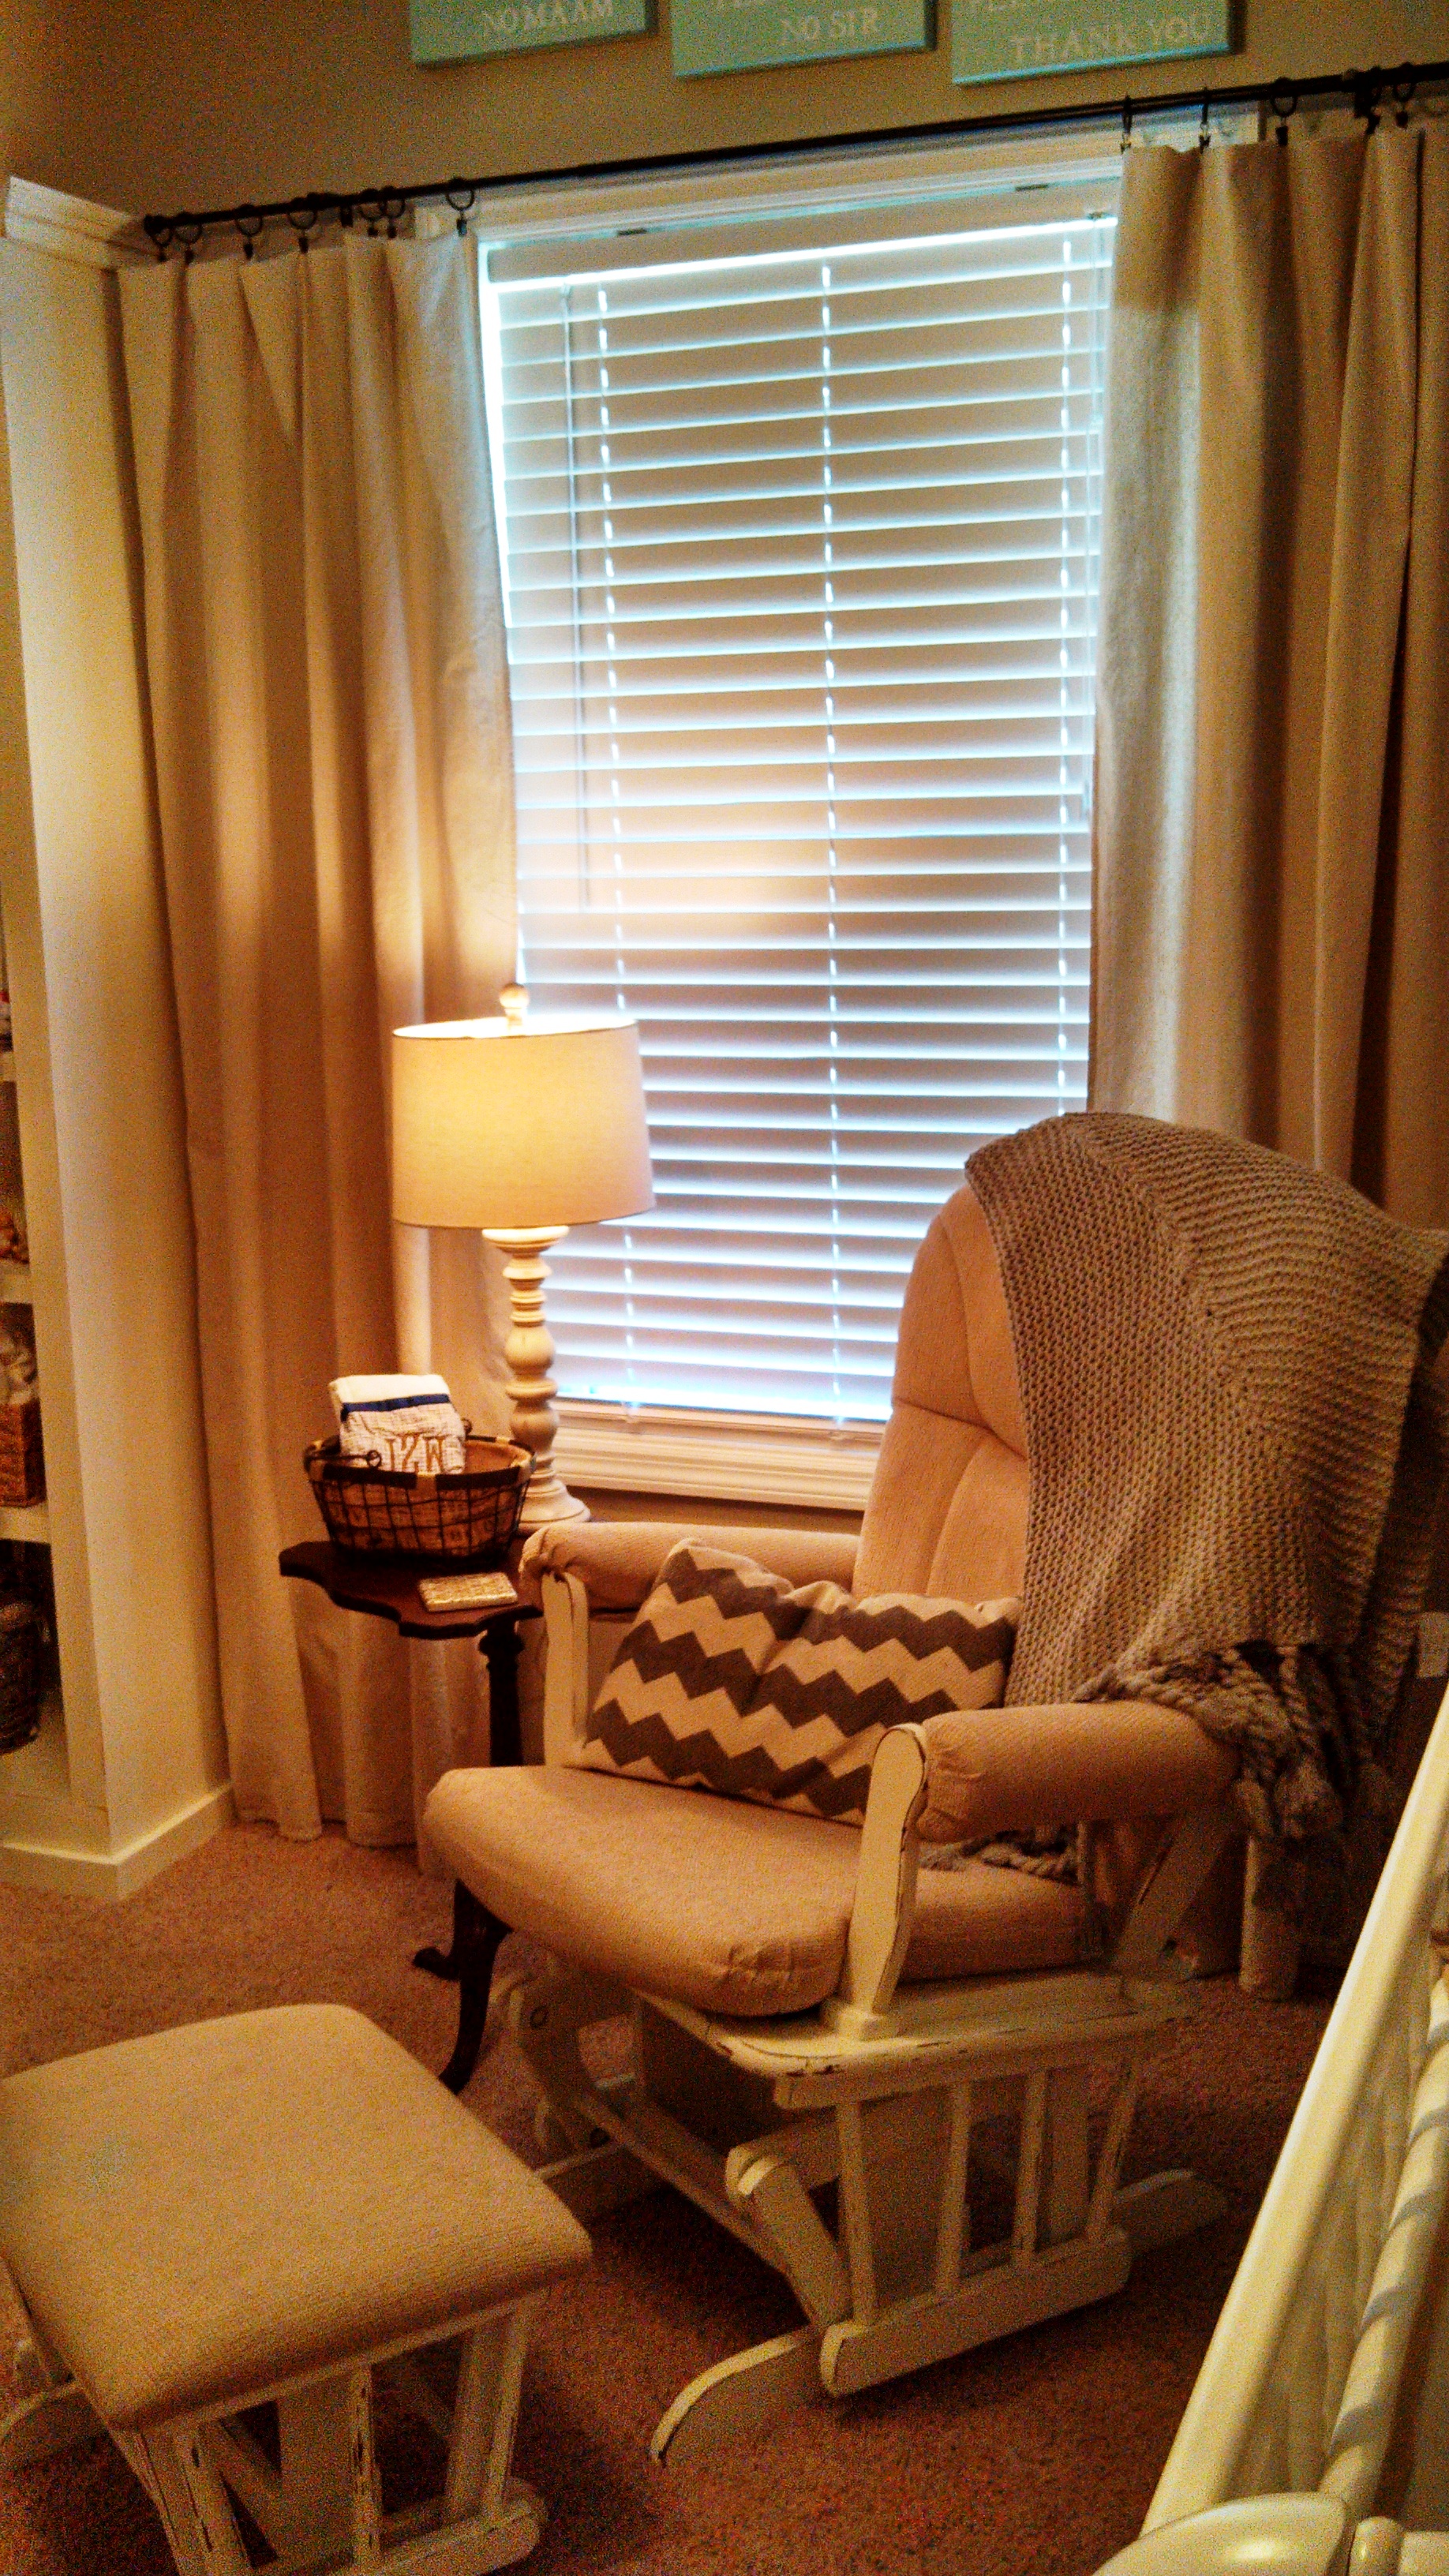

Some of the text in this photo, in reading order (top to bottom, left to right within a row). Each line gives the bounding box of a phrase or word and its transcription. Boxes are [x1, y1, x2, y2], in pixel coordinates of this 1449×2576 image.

[481, 6, 519, 37] NO
[779, 6, 879, 47] NO SIR
[1009, 12, 1211, 64] THANK YOU
